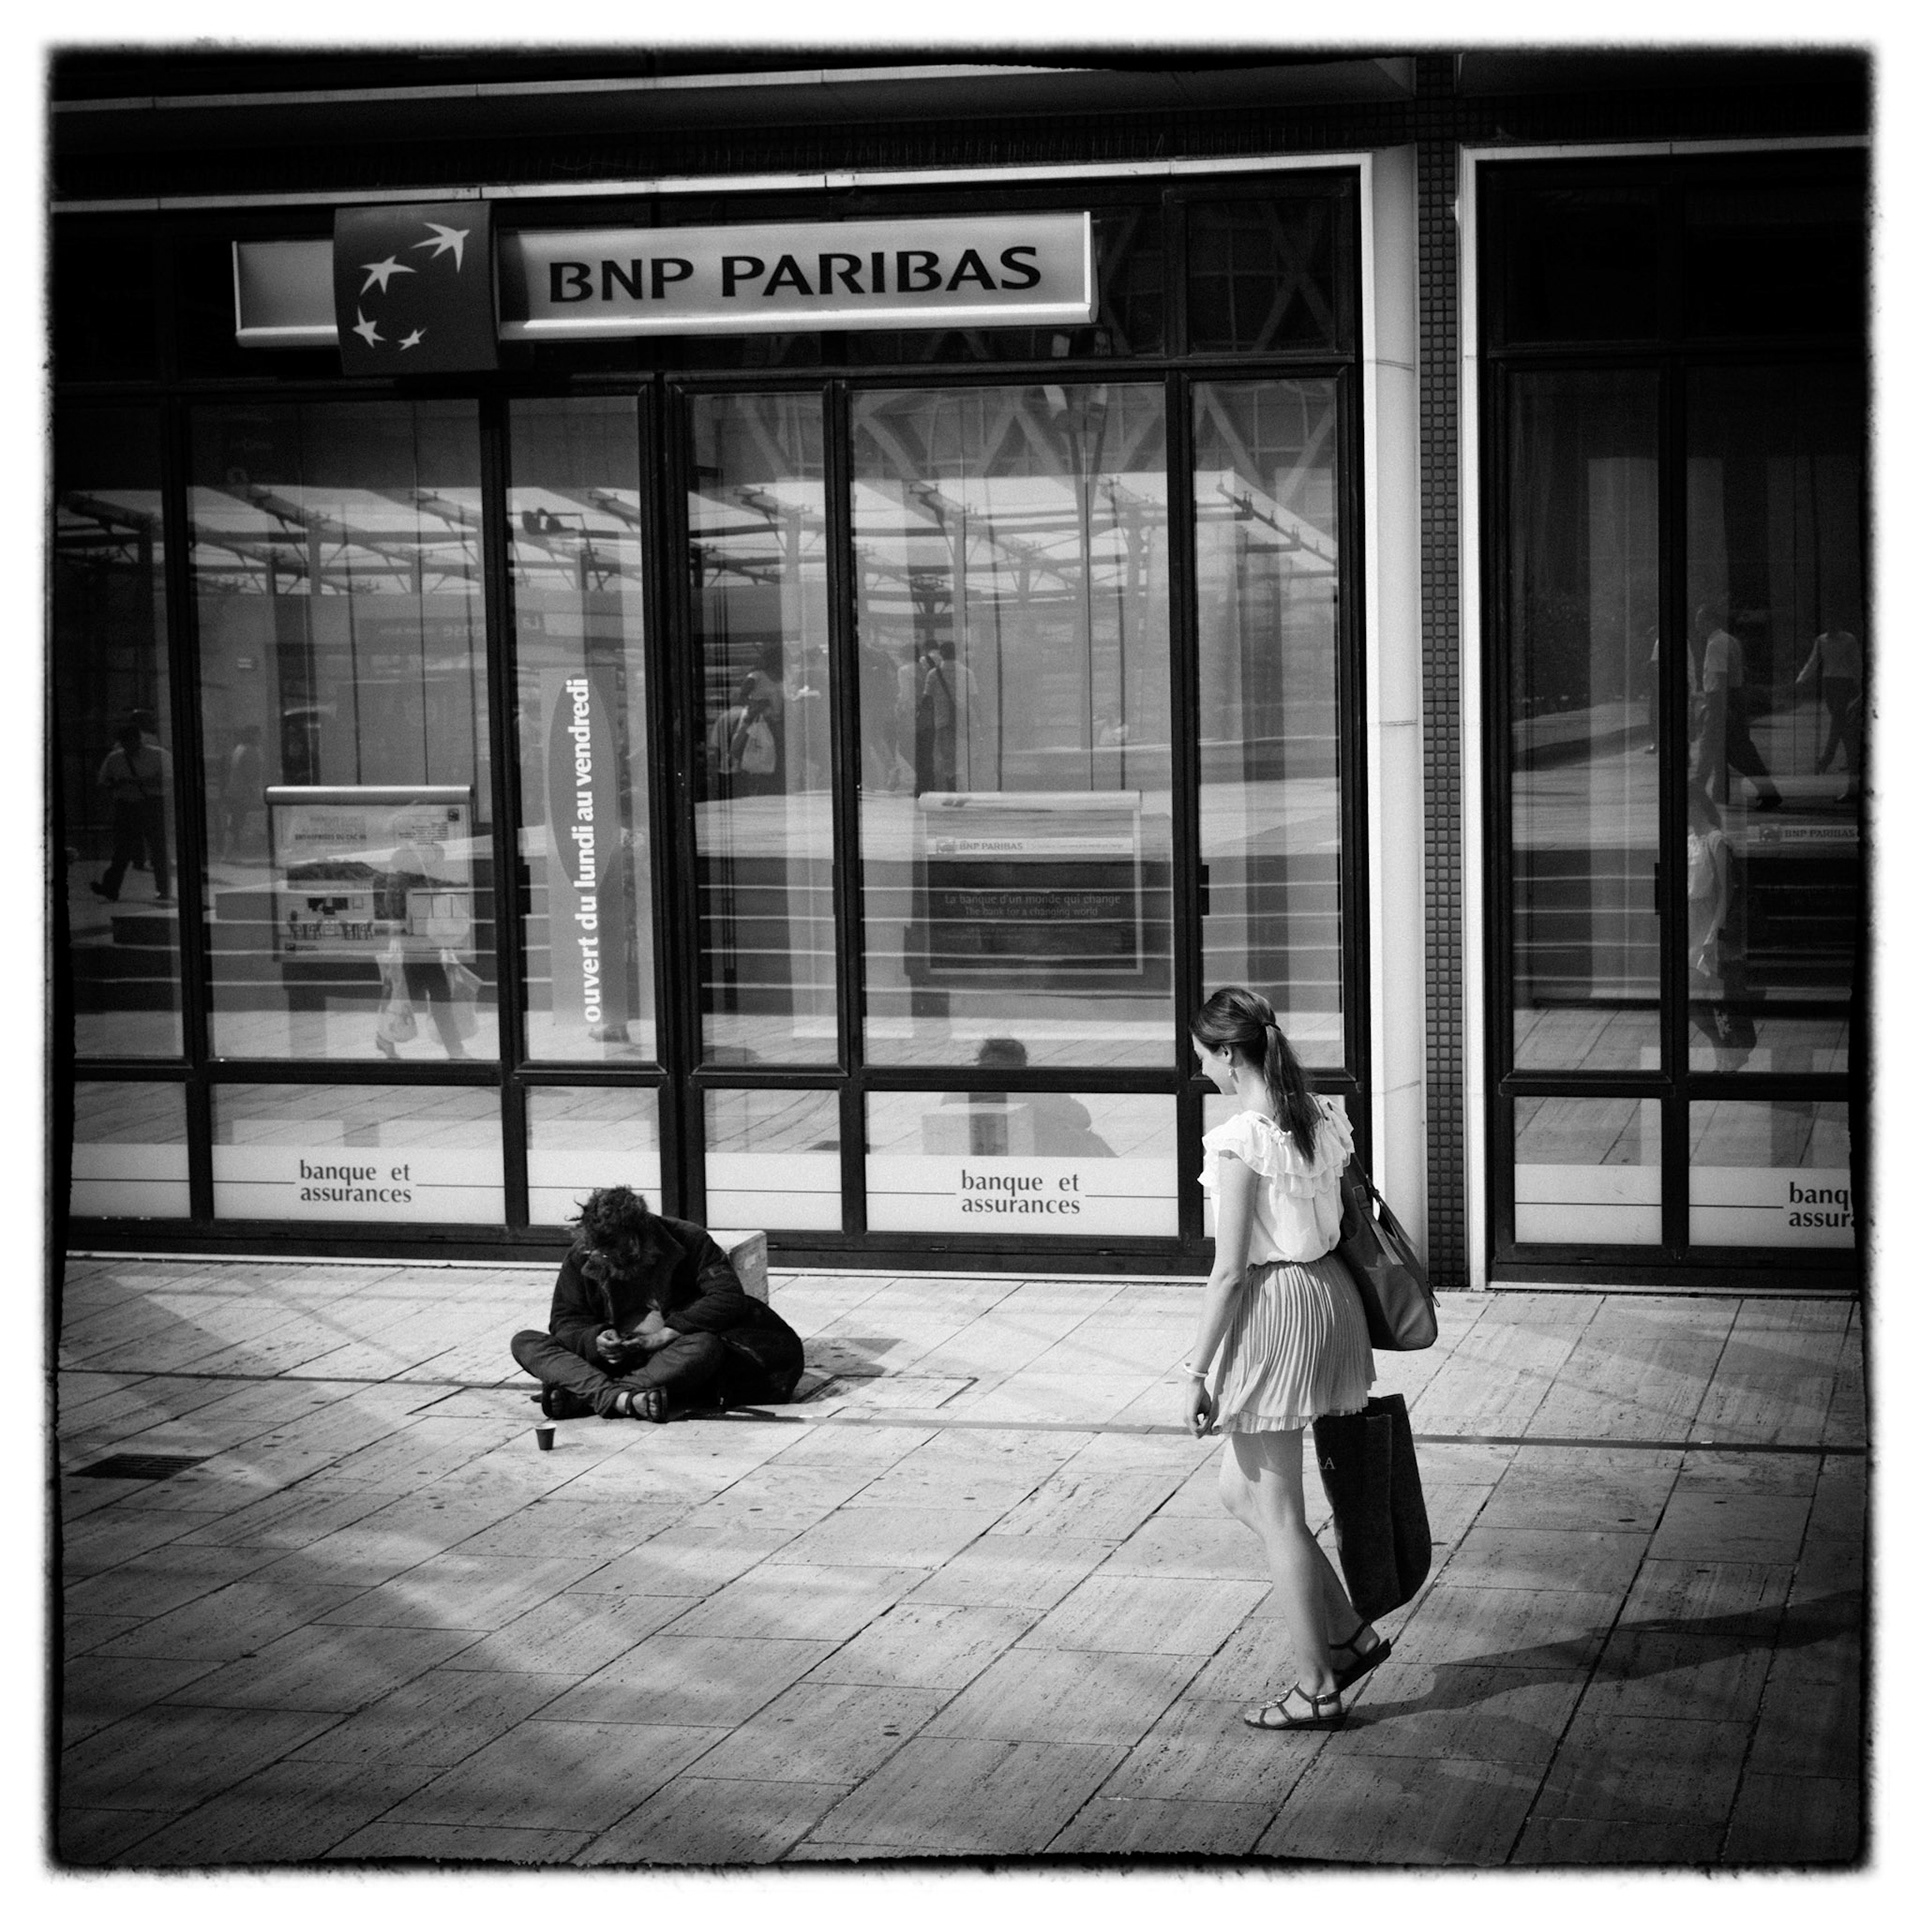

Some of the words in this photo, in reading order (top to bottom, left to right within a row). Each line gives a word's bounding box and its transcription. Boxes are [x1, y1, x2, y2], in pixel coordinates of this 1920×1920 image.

[549, 257, 694, 303] BNP
[721, 246, 1041, 297] PARIBAS
[565, 678, 593, 787] vendredi
[576, 791, 594, 821] au
[959, 841, 979, 851] BNP
[981, 841, 1023, 851] PARIBAS
[1785, 829, 1807, 838] BNP
[571, 825, 596, 887] lundi
[574, 895, 598, 930] du
[959, 893, 996, 907] banque
[1025, 894, 1060, 904] monde
[1064, 893, 1080, 907] qui
[1083, 893, 1121, 907] change
[1073, 906, 1098, 916] world
[577, 936, 601, 1022] ouvert
[300, 1159, 377, 1186] banque
[391, 1164, 411, 1181] et
[961, 1169, 1043, 1197] banque
[1058, 1174, 1080, 1192] et
[300, 1187, 412, 1203] assurances
[961, 1198, 1081, 1214] assurances
[1789, 1181, 1849, 1211] banq
